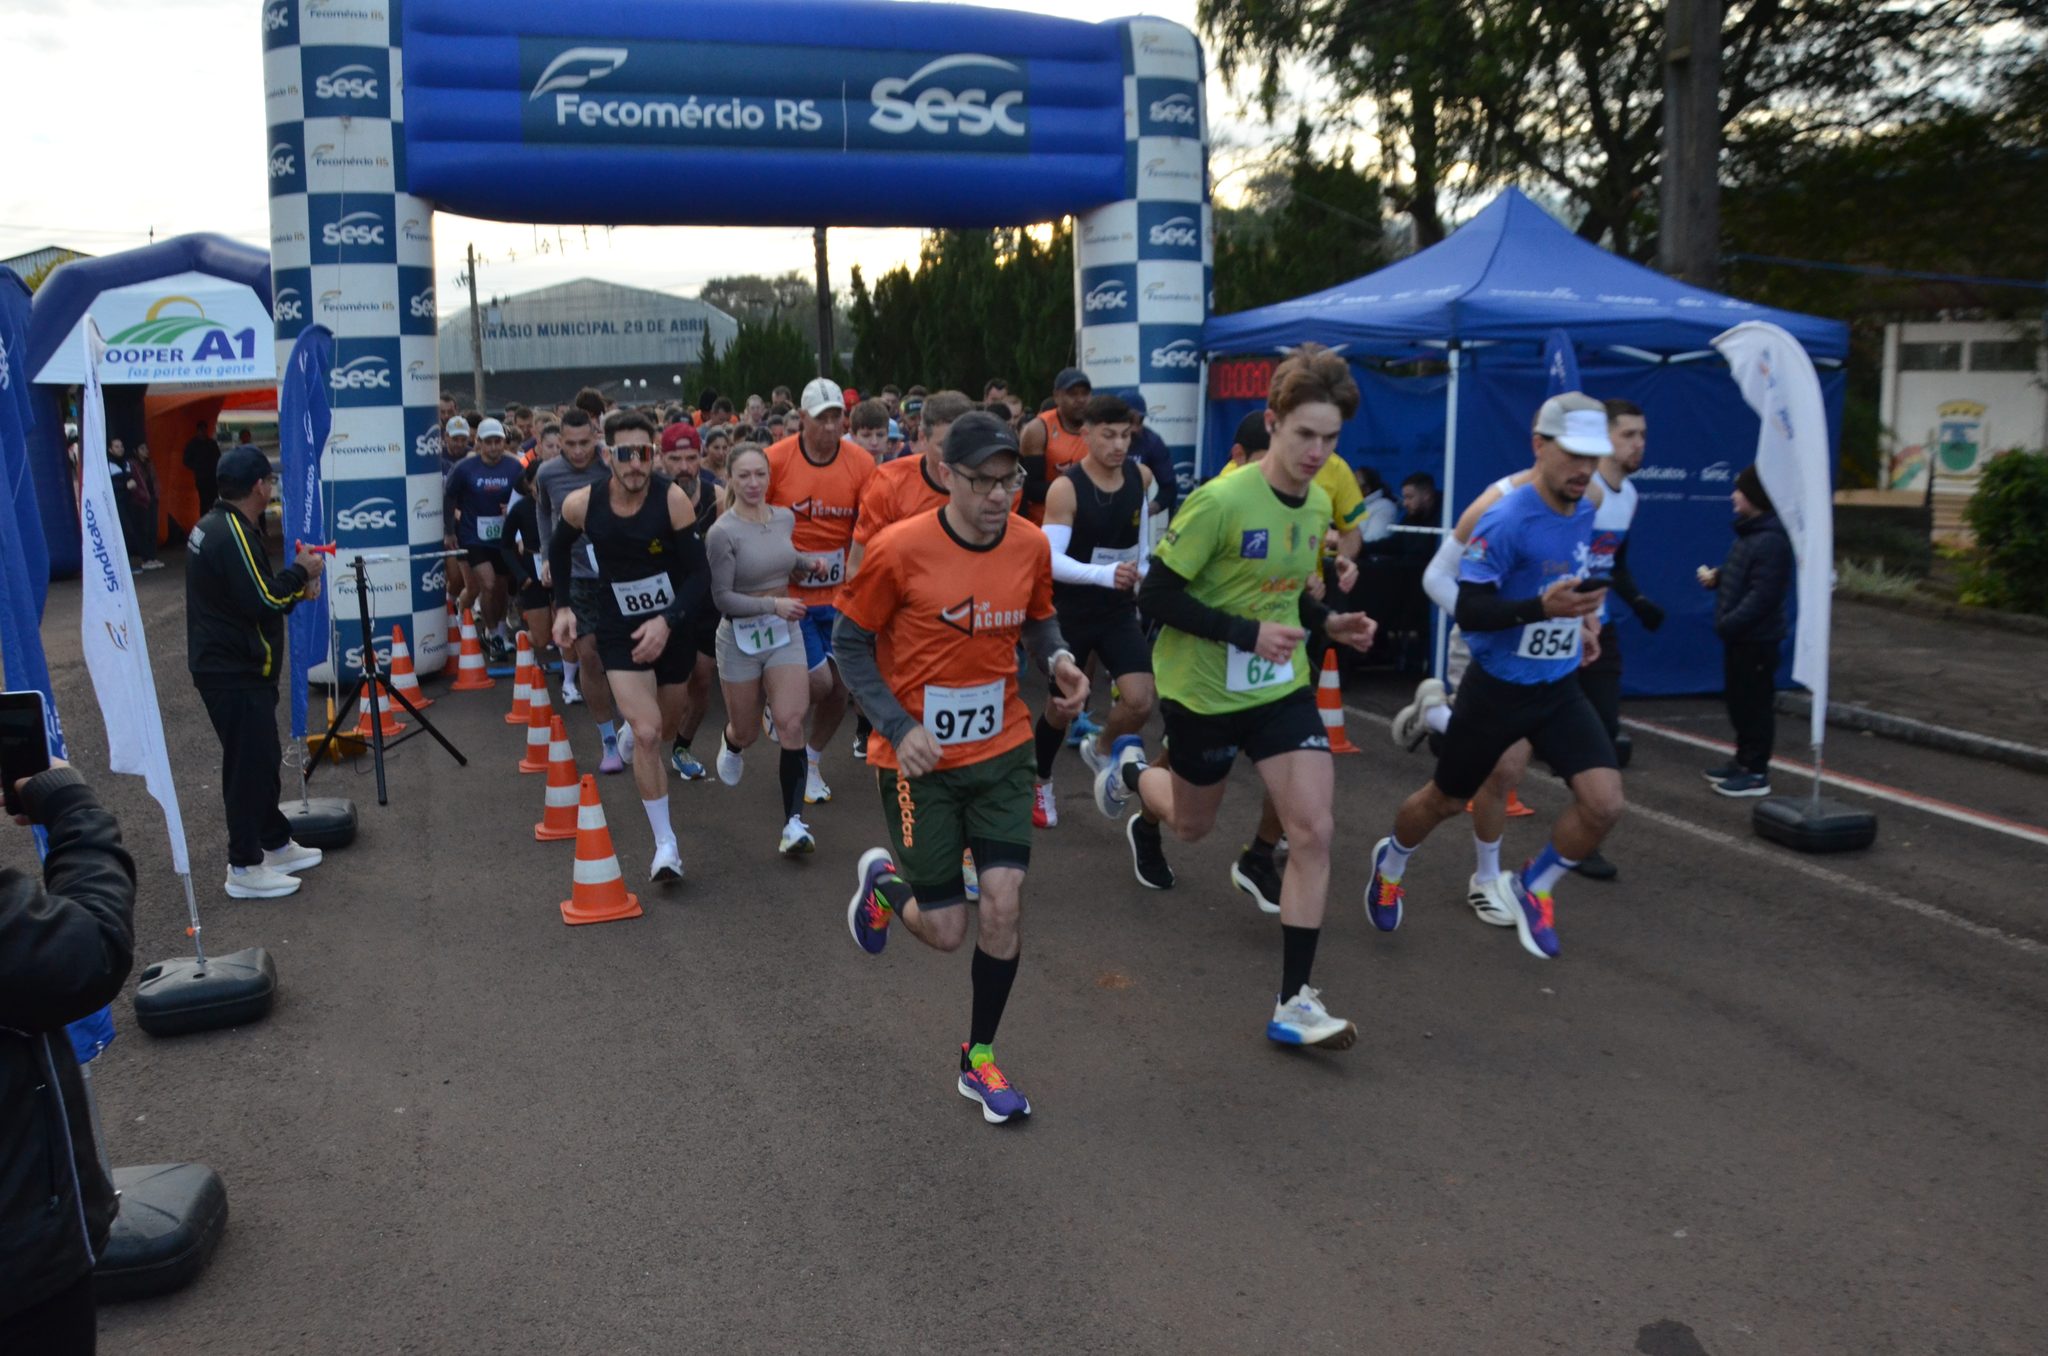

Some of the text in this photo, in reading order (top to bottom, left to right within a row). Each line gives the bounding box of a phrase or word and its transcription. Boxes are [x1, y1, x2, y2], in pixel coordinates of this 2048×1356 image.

[315, 75, 379, 100] Sesc
[556, 93, 822, 132] Fecomércio RS
[869, 76, 1026, 137] Sesc
[322, 222, 385, 246] Sesc
[537, 321, 618, 338] MUNICIPAL
[647, 318, 665, 333] DE
[670, 316, 705, 332] ABRI
[105, 327, 256, 363] OOPER A1
[152, 366, 191, 380] parte
[215, 363, 256, 378] gente
[329, 367, 391, 390] Sesc
[336, 508, 397, 531] Sesc
[84, 498, 120, 593] Sindicatos
[624, 588, 669, 612] 884
[750, 626, 775, 649] 11
[1527, 628, 1575, 656] 854
[1247, 656, 1275, 685] 62
[934, 704, 996, 740] 973
[896, 779, 916, 848] adidas
